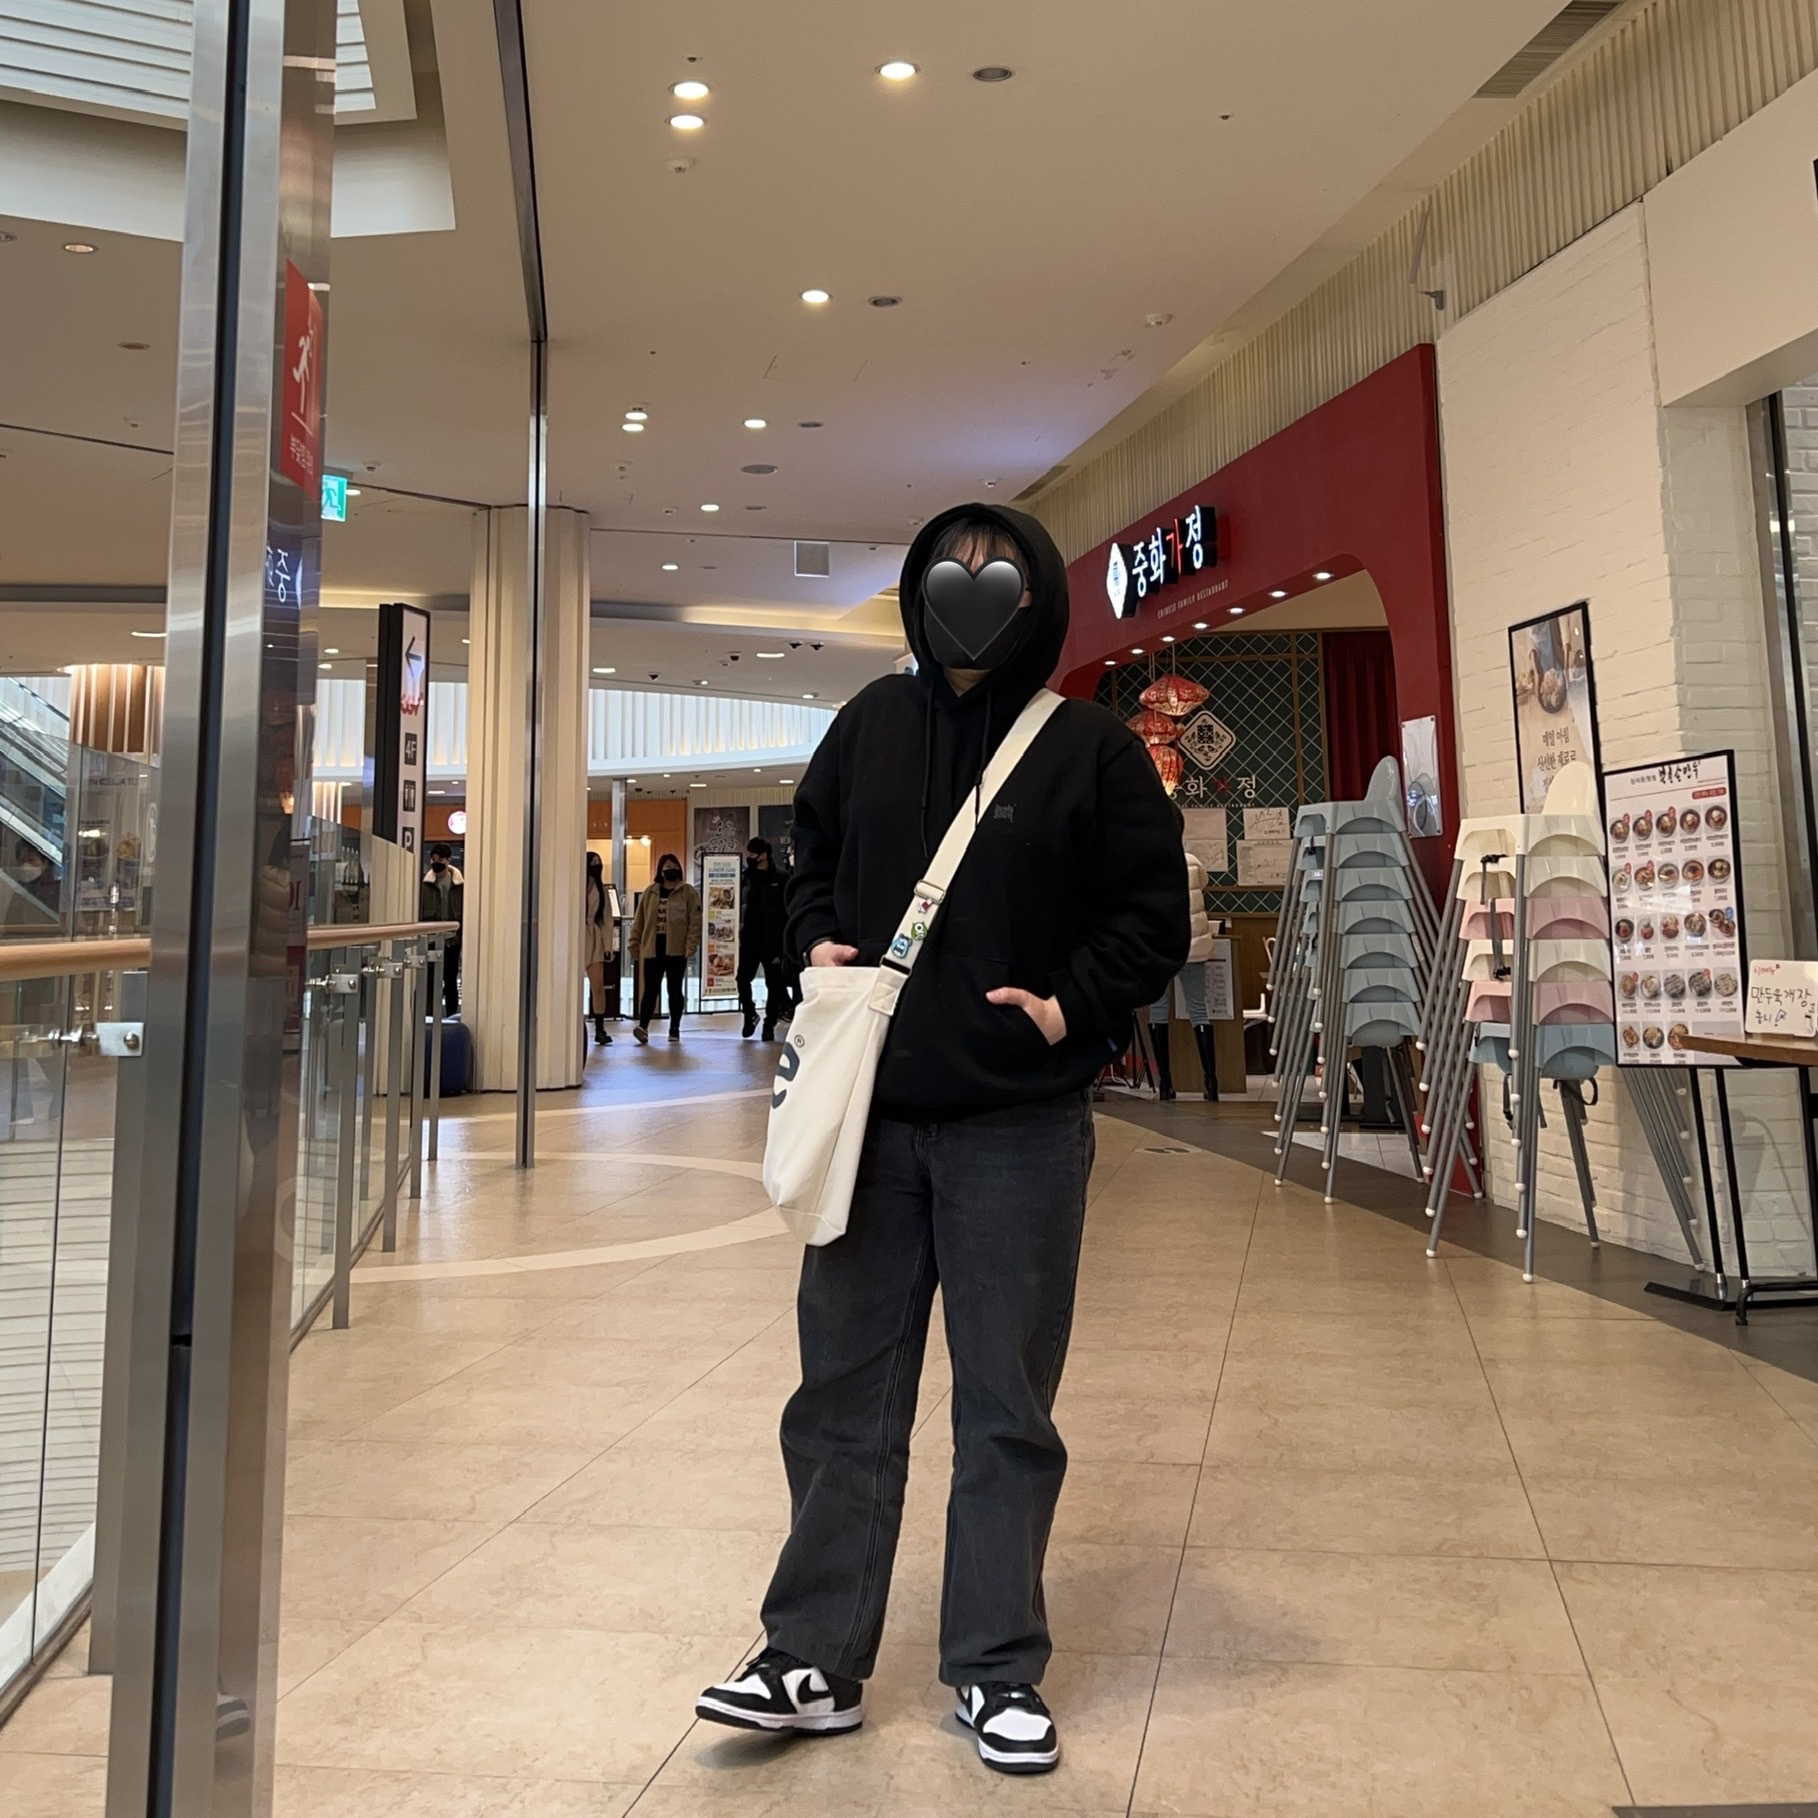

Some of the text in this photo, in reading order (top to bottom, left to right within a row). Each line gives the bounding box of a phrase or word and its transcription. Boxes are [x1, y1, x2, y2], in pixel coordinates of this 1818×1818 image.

[1132, 504, 1204, 598] 중화가정
[1542, 726, 1570, 747] 매일 아침
[405, 740, 417, 759] 4F
[1537, 751, 1557, 772] 신선한
[1750, 986, 1813, 1008] 만두육개장
